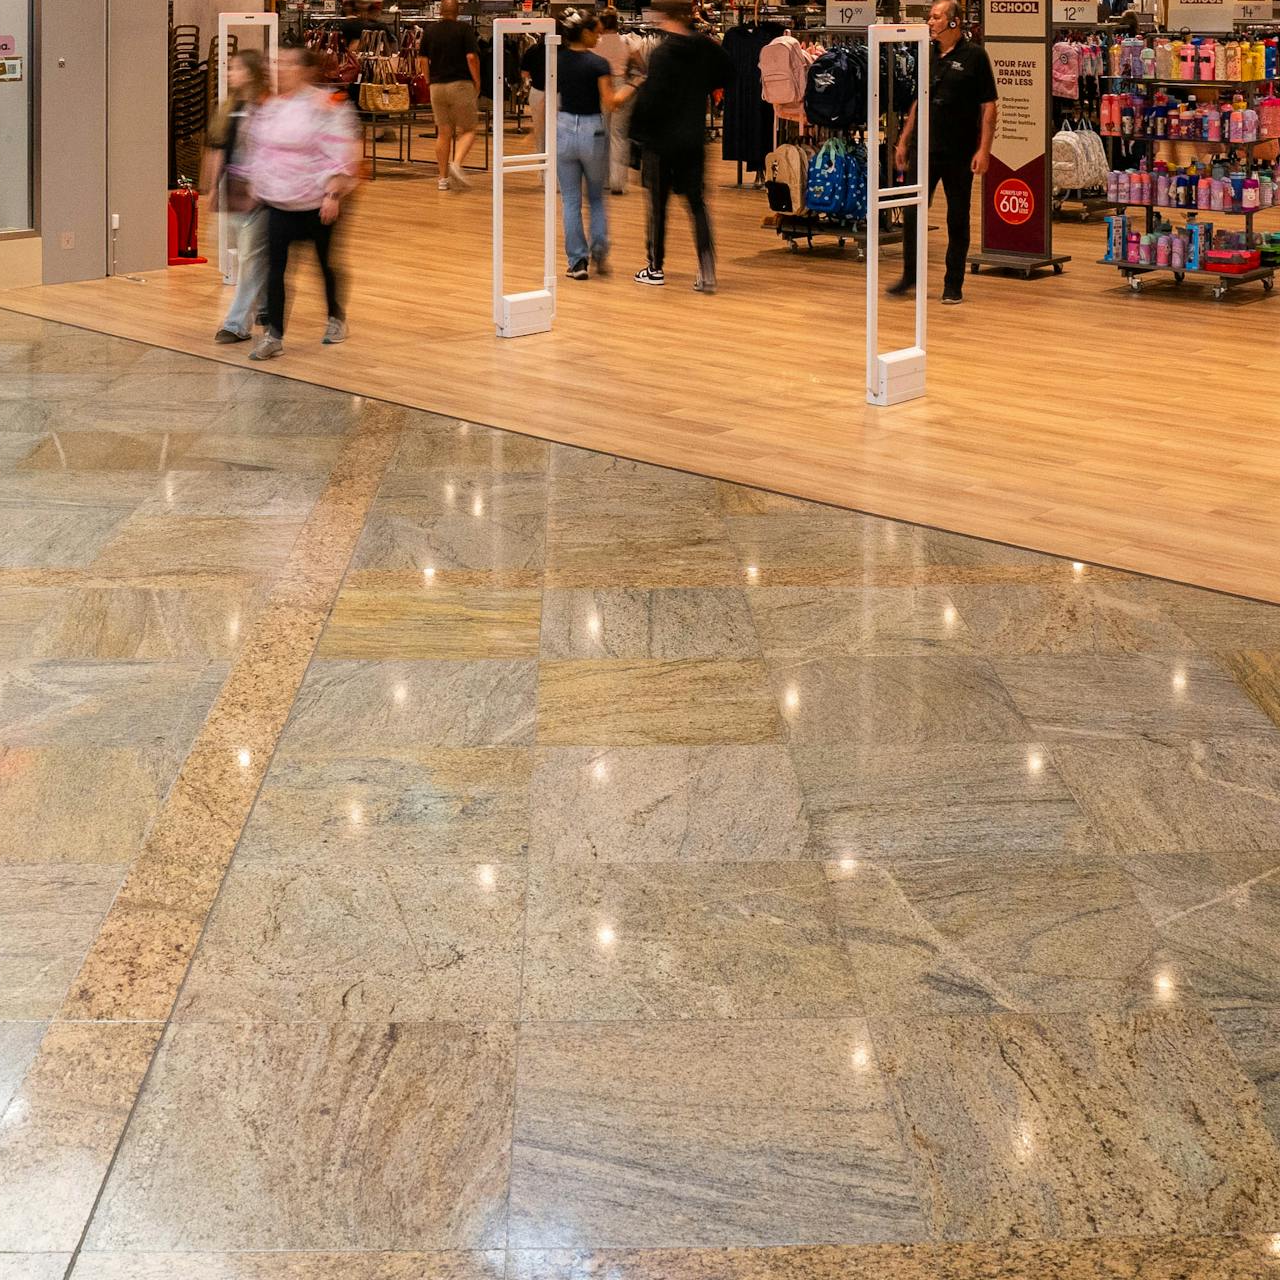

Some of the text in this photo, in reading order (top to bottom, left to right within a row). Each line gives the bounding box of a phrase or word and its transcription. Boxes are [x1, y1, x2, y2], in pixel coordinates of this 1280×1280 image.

[991, 2, 1039, 13] SCHOOL
[993, 60, 1037, 68] YOUR FAVE
[998, 69, 1031, 77] BRANDS
[1015, 78, 1033, 86] LESS
[1000, 195, 1029, 214] 60%
